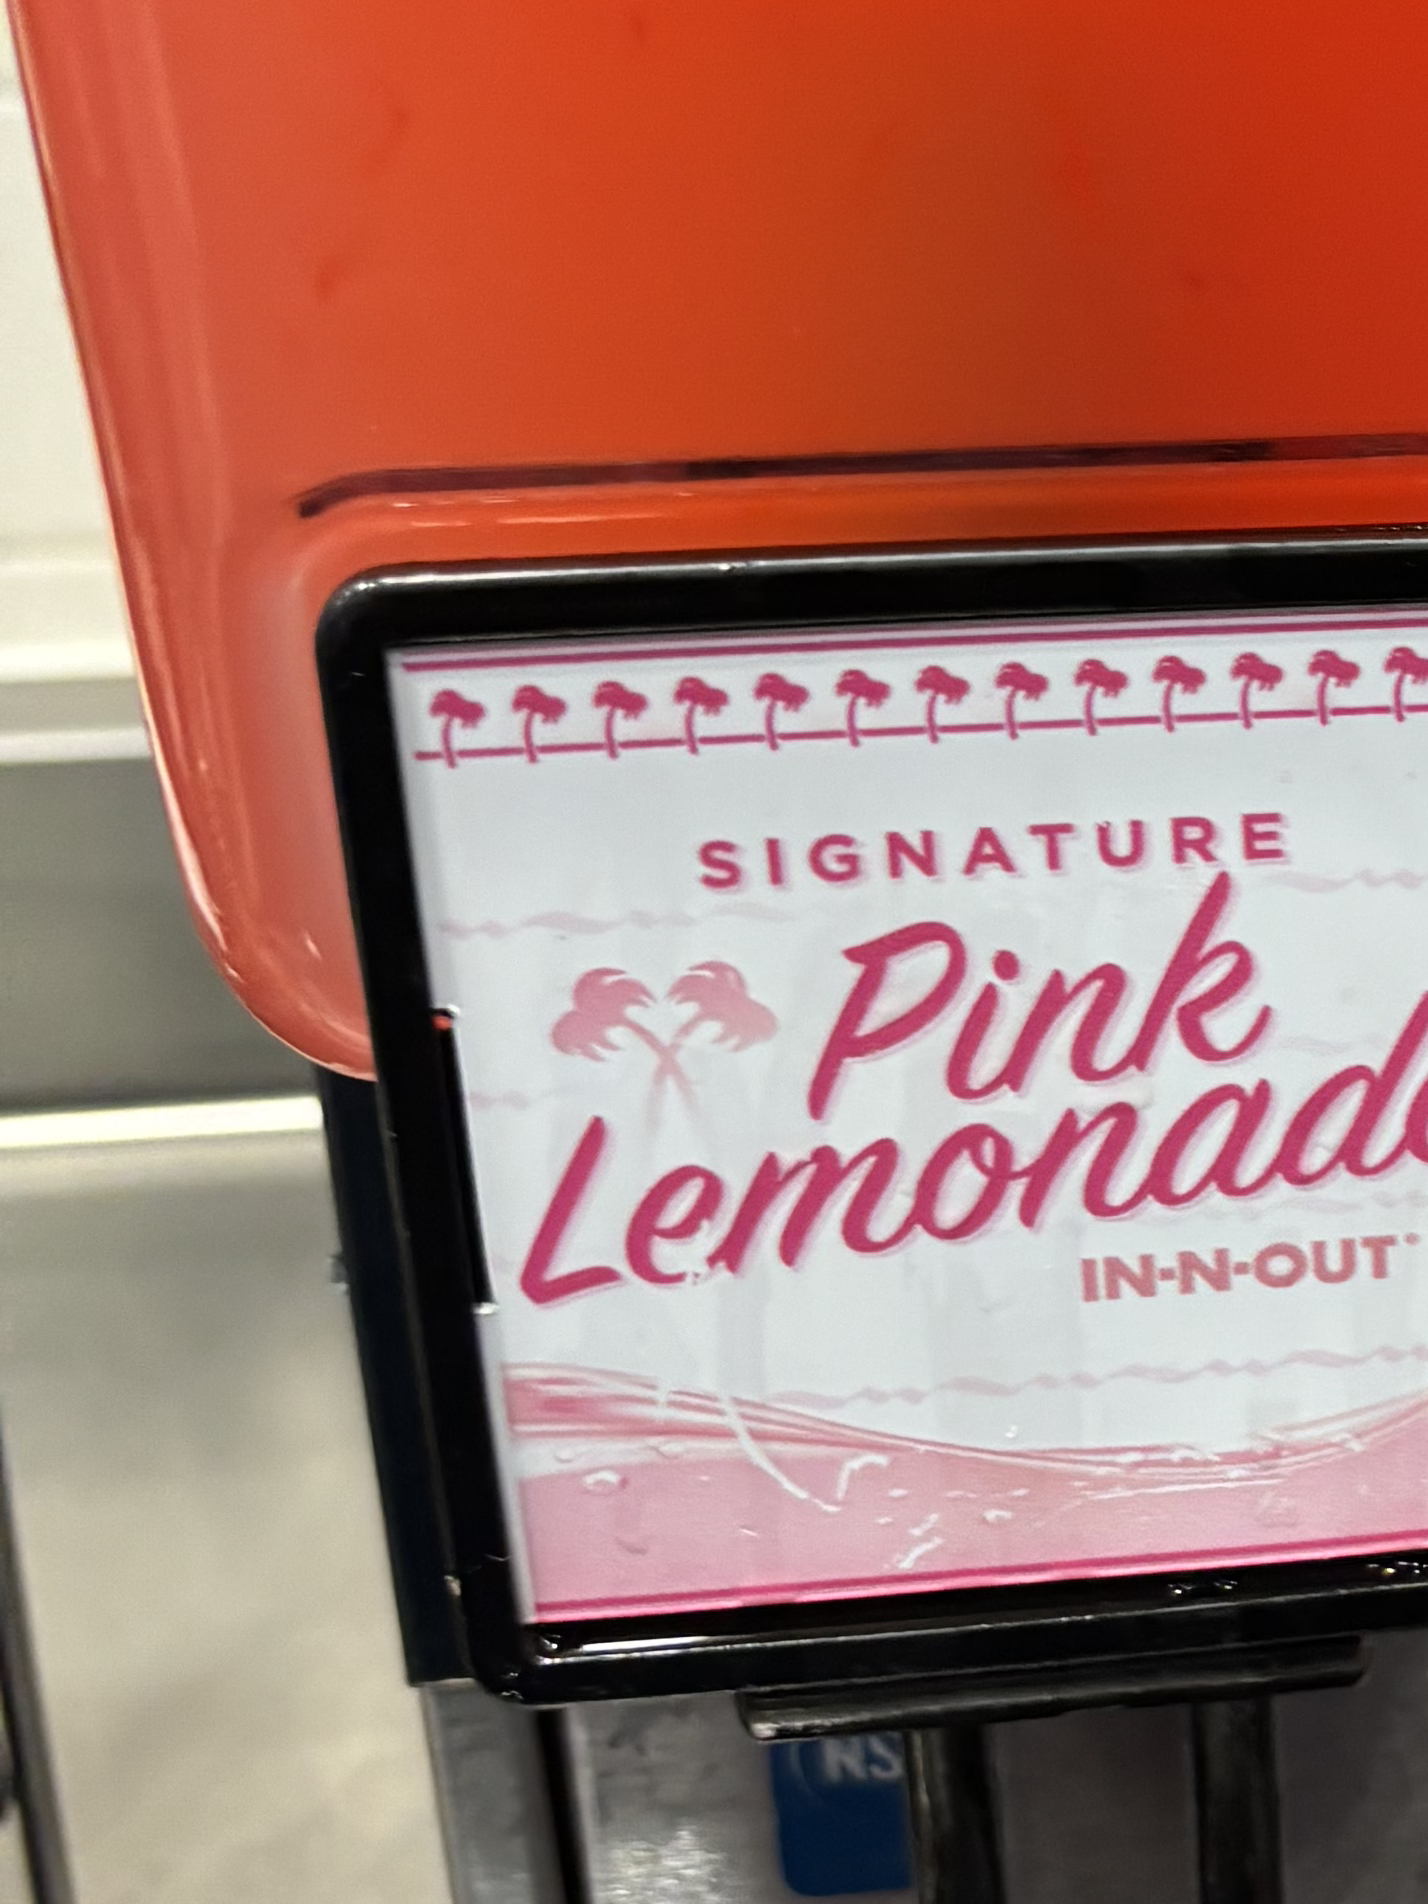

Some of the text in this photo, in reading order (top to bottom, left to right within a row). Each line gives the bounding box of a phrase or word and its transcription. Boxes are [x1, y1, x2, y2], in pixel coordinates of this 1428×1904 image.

[698, 812, 1284, 890] SIGNATURE
[807, 872, 1272, 1120] Pink
[1080, 1233, 1400, 1303] IN-N-OUT
